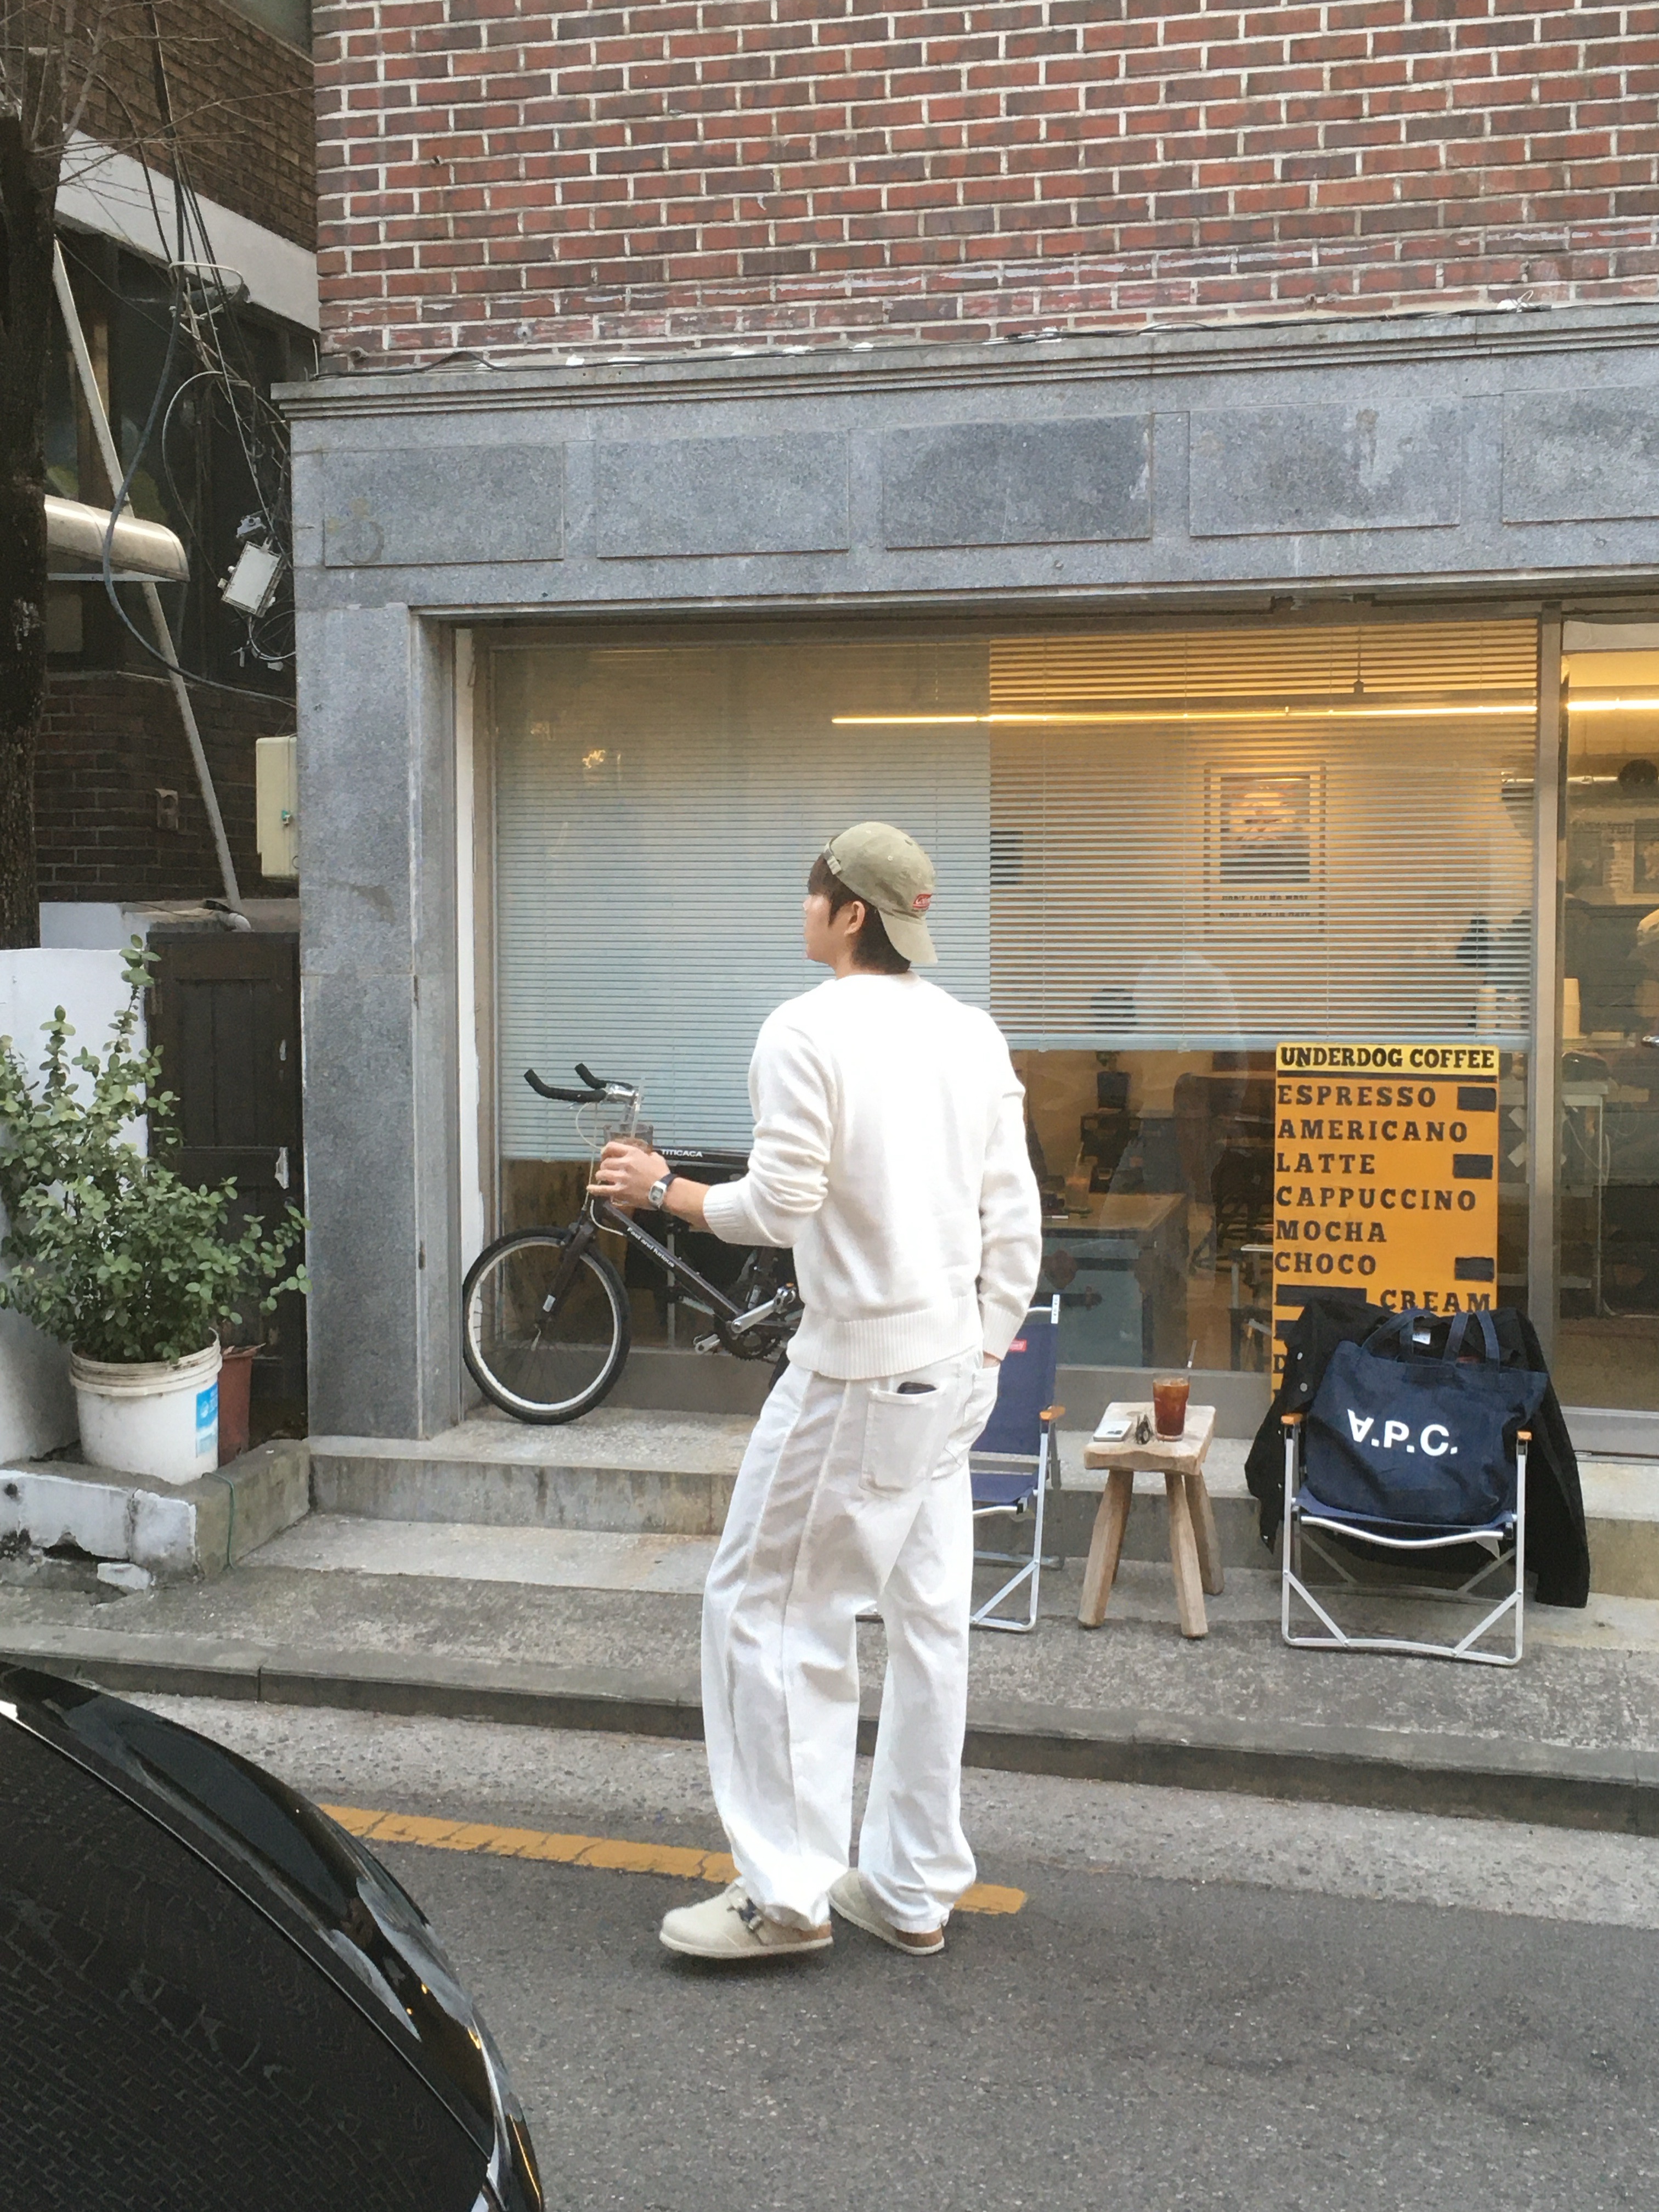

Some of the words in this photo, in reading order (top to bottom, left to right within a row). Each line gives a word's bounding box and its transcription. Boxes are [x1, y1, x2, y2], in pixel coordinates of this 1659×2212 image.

[1281, 1047, 1403, 1068] UNDERDOG
[1409, 1048, 1494, 1069] COFFEE
[1277, 1085, 1436, 1108] ESPRESSO
[1277, 1119, 1468, 1143] AMERICANO
[660, 1148, 703, 1158] TITICACA
[1276, 1153, 1375, 1175] LATTE
[1276, 1186, 1476, 1211] CAPPUCCINO
[1276, 1220, 1387, 1243] MOCHA
[1274, 1251, 1376, 1276] CHOCO
[1379, 1289, 1492, 1312] CREAM
